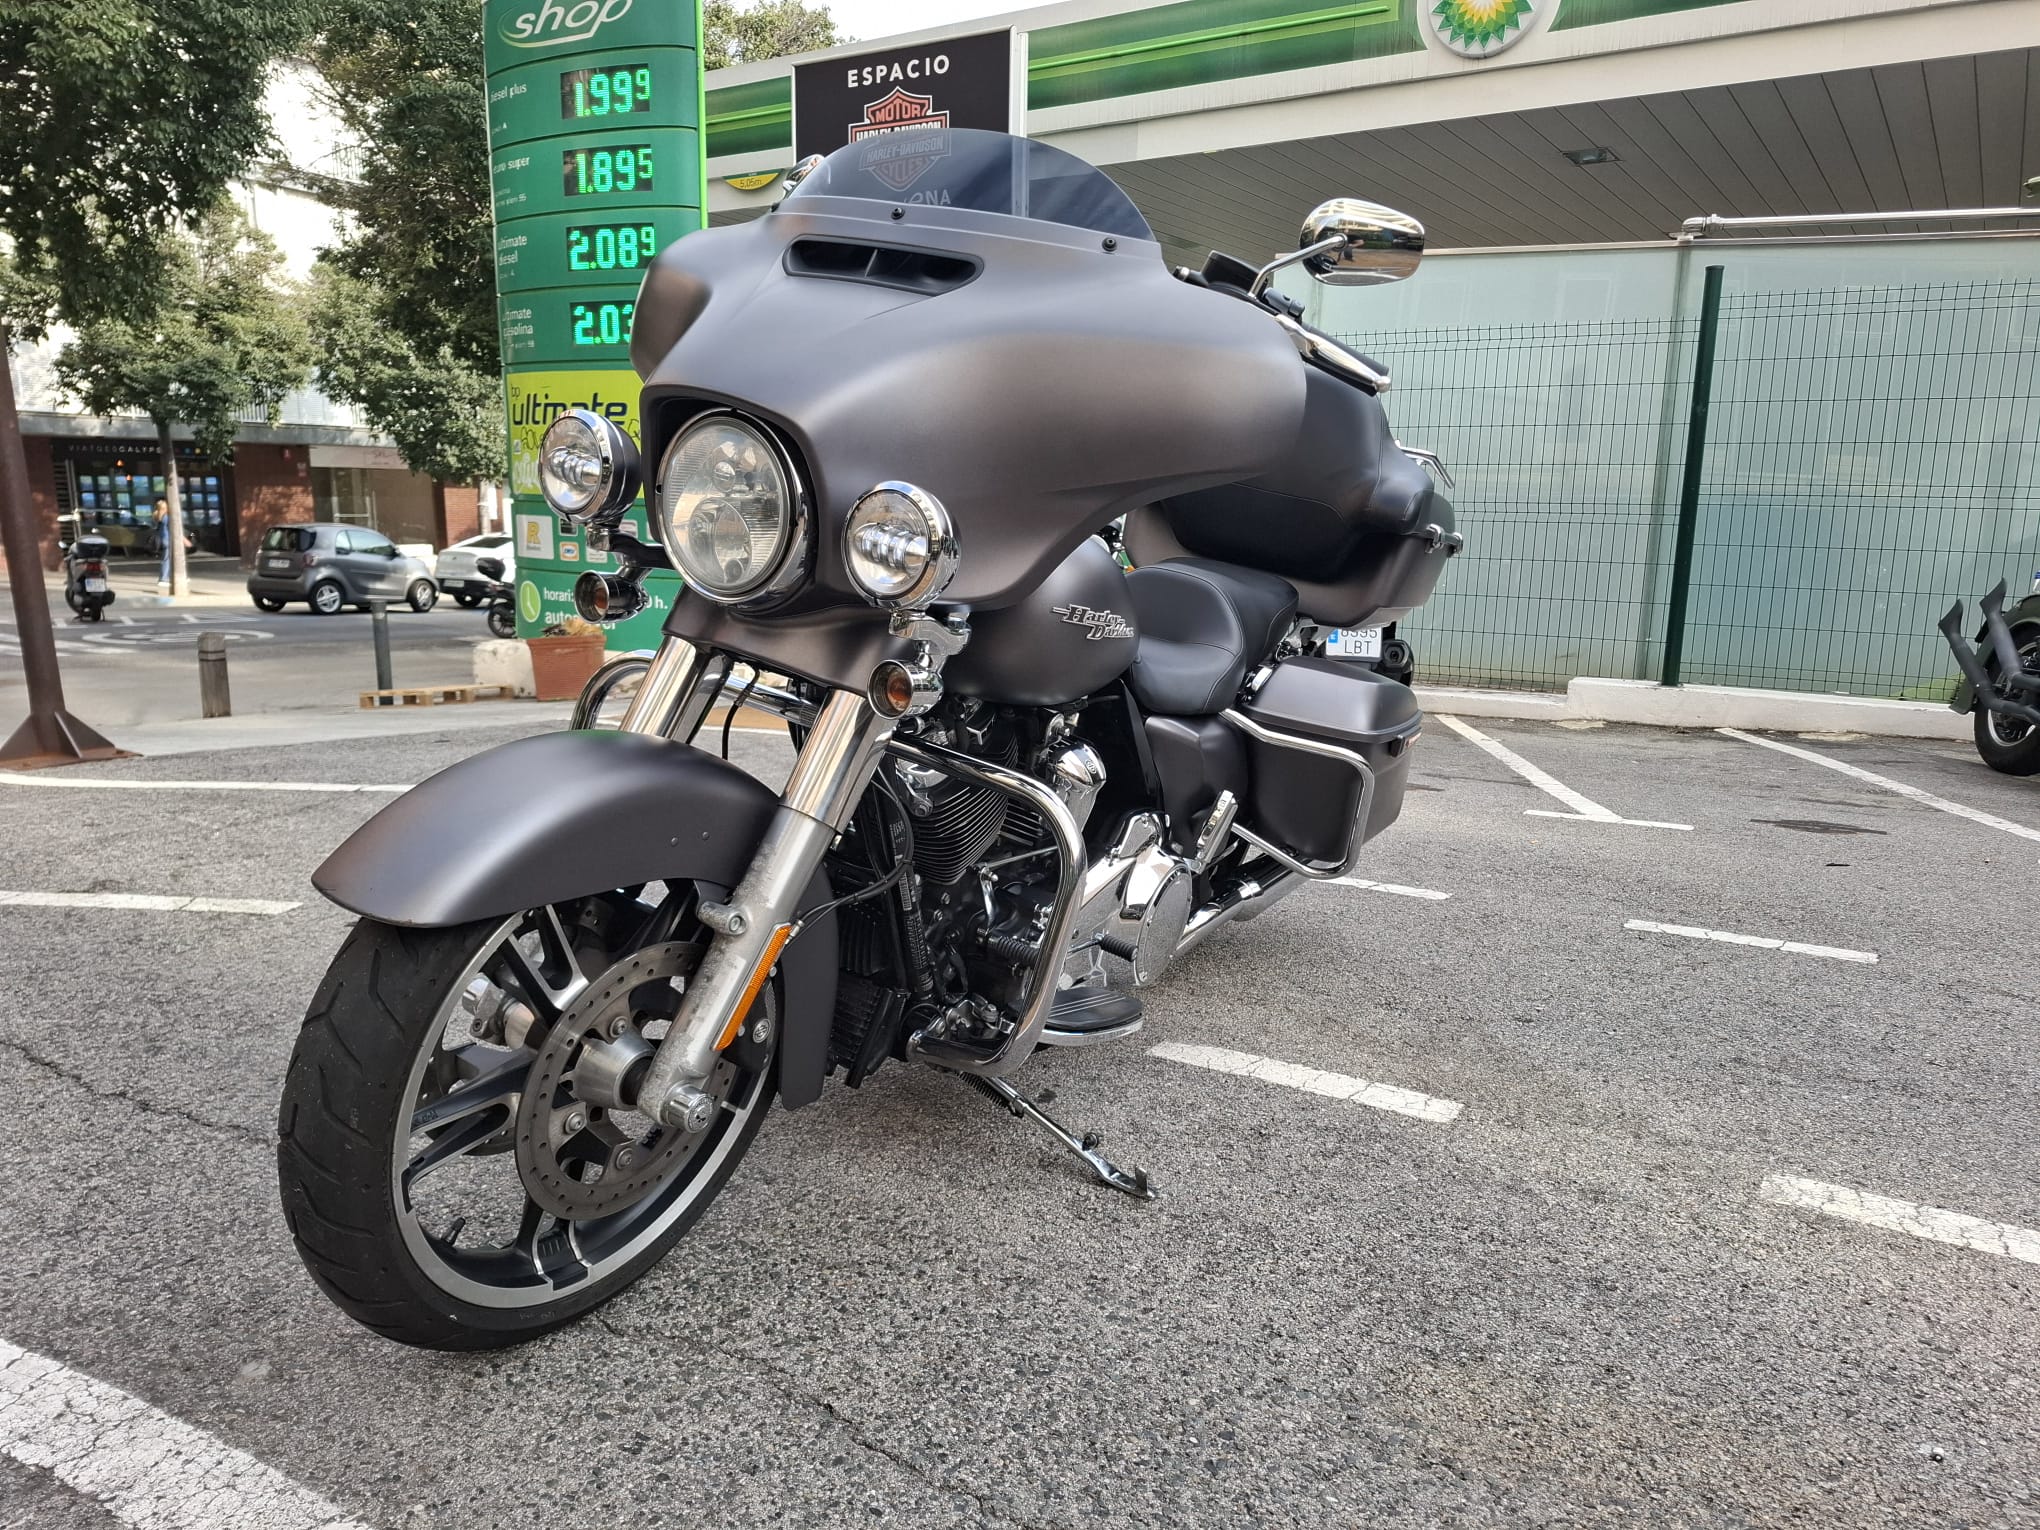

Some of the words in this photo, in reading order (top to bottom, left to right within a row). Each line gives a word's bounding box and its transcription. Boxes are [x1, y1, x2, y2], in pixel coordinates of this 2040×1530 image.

[515, 0, 632, 38] shop
[847, 54, 950, 88] ESPACIO
[509, 83, 528, 99] plus
[575, 68, 651, 117] 1.999
[875, 98, 921, 123] MOTOR
[507, 157, 530, 171] super
[575, 148, 653, 194] 1.895
[880, 155, 926, 182] CYCLES
[904, 189, 952, 205] ONA
[568, 226, 656, 270] 2.089
[502, 308, 532, 322] timate
[1344, 639, 1372, 654] LBT
